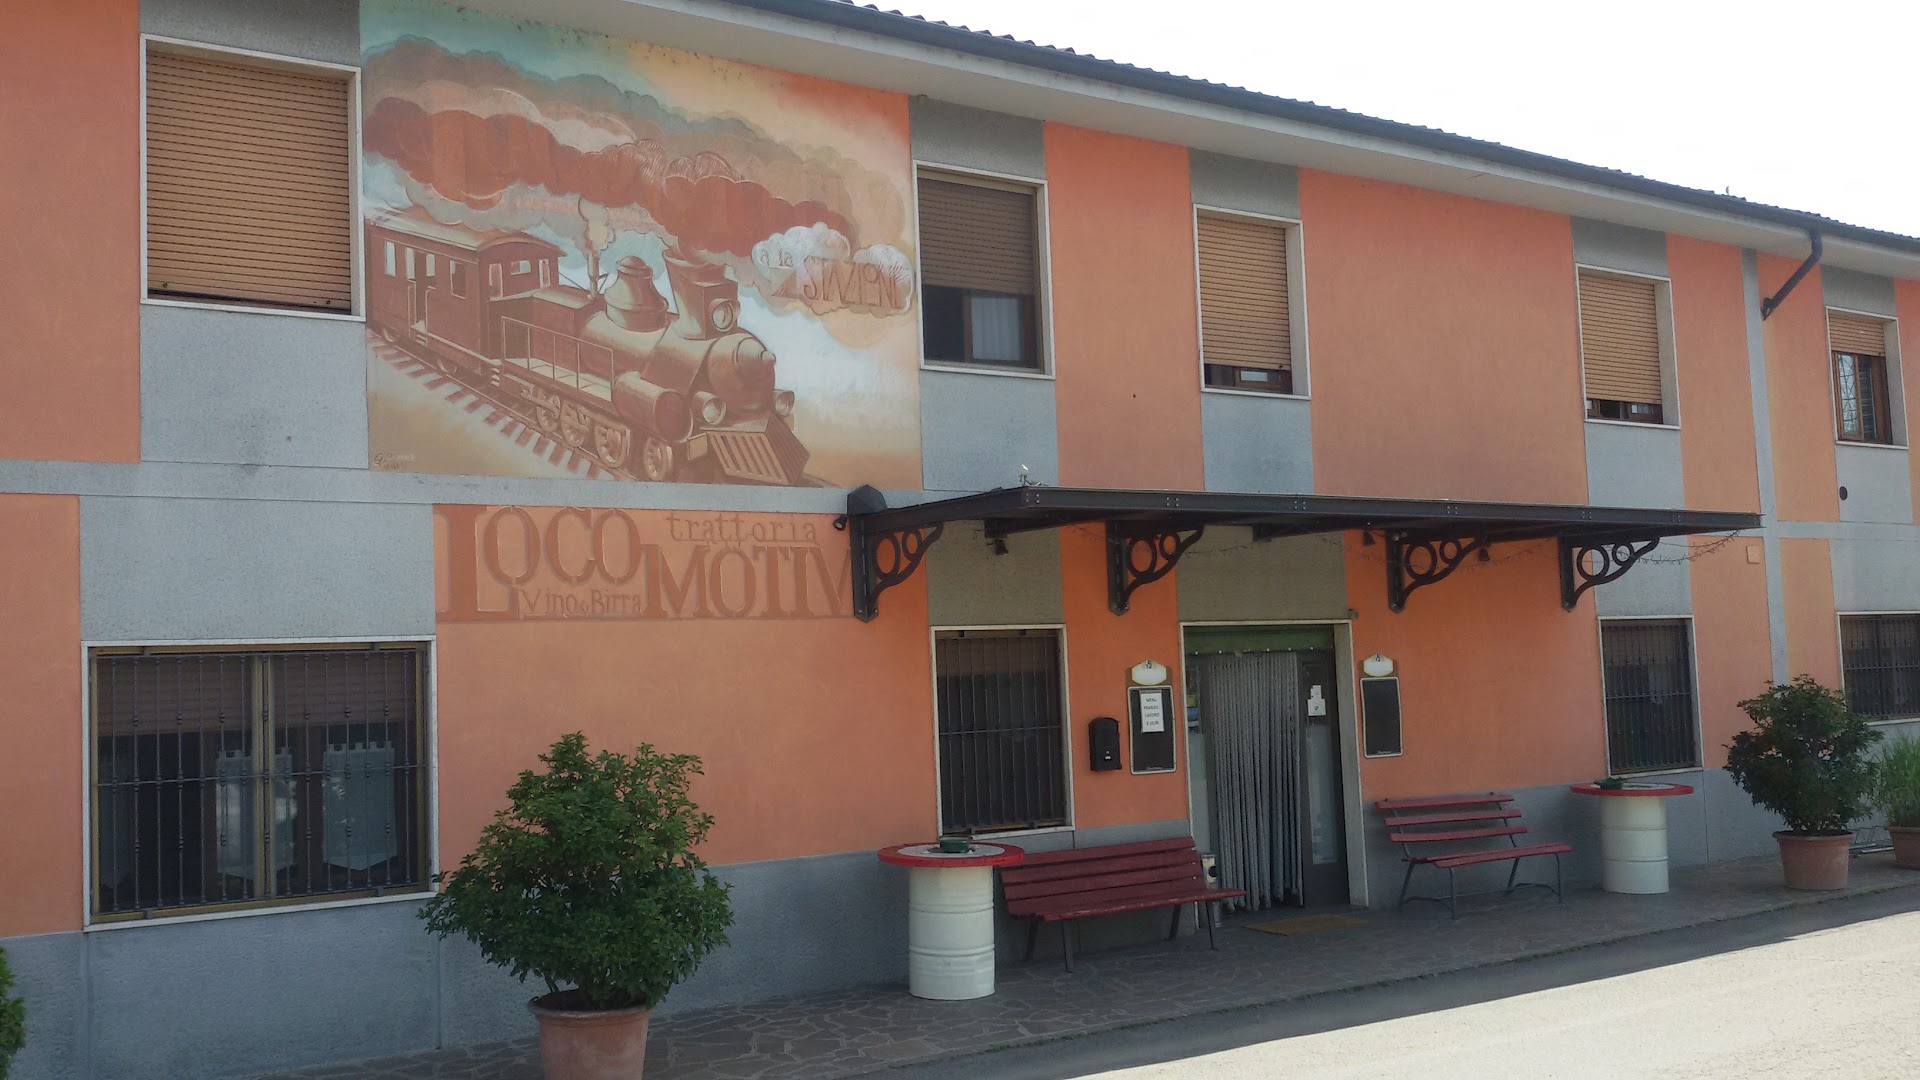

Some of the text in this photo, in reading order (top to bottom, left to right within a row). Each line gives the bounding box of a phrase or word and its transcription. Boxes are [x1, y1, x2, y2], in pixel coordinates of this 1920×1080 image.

[665, 512, 818, 544] trattoria
[521, 587, 577, 614] Vino
[590, 588, 642, 614] Birra
